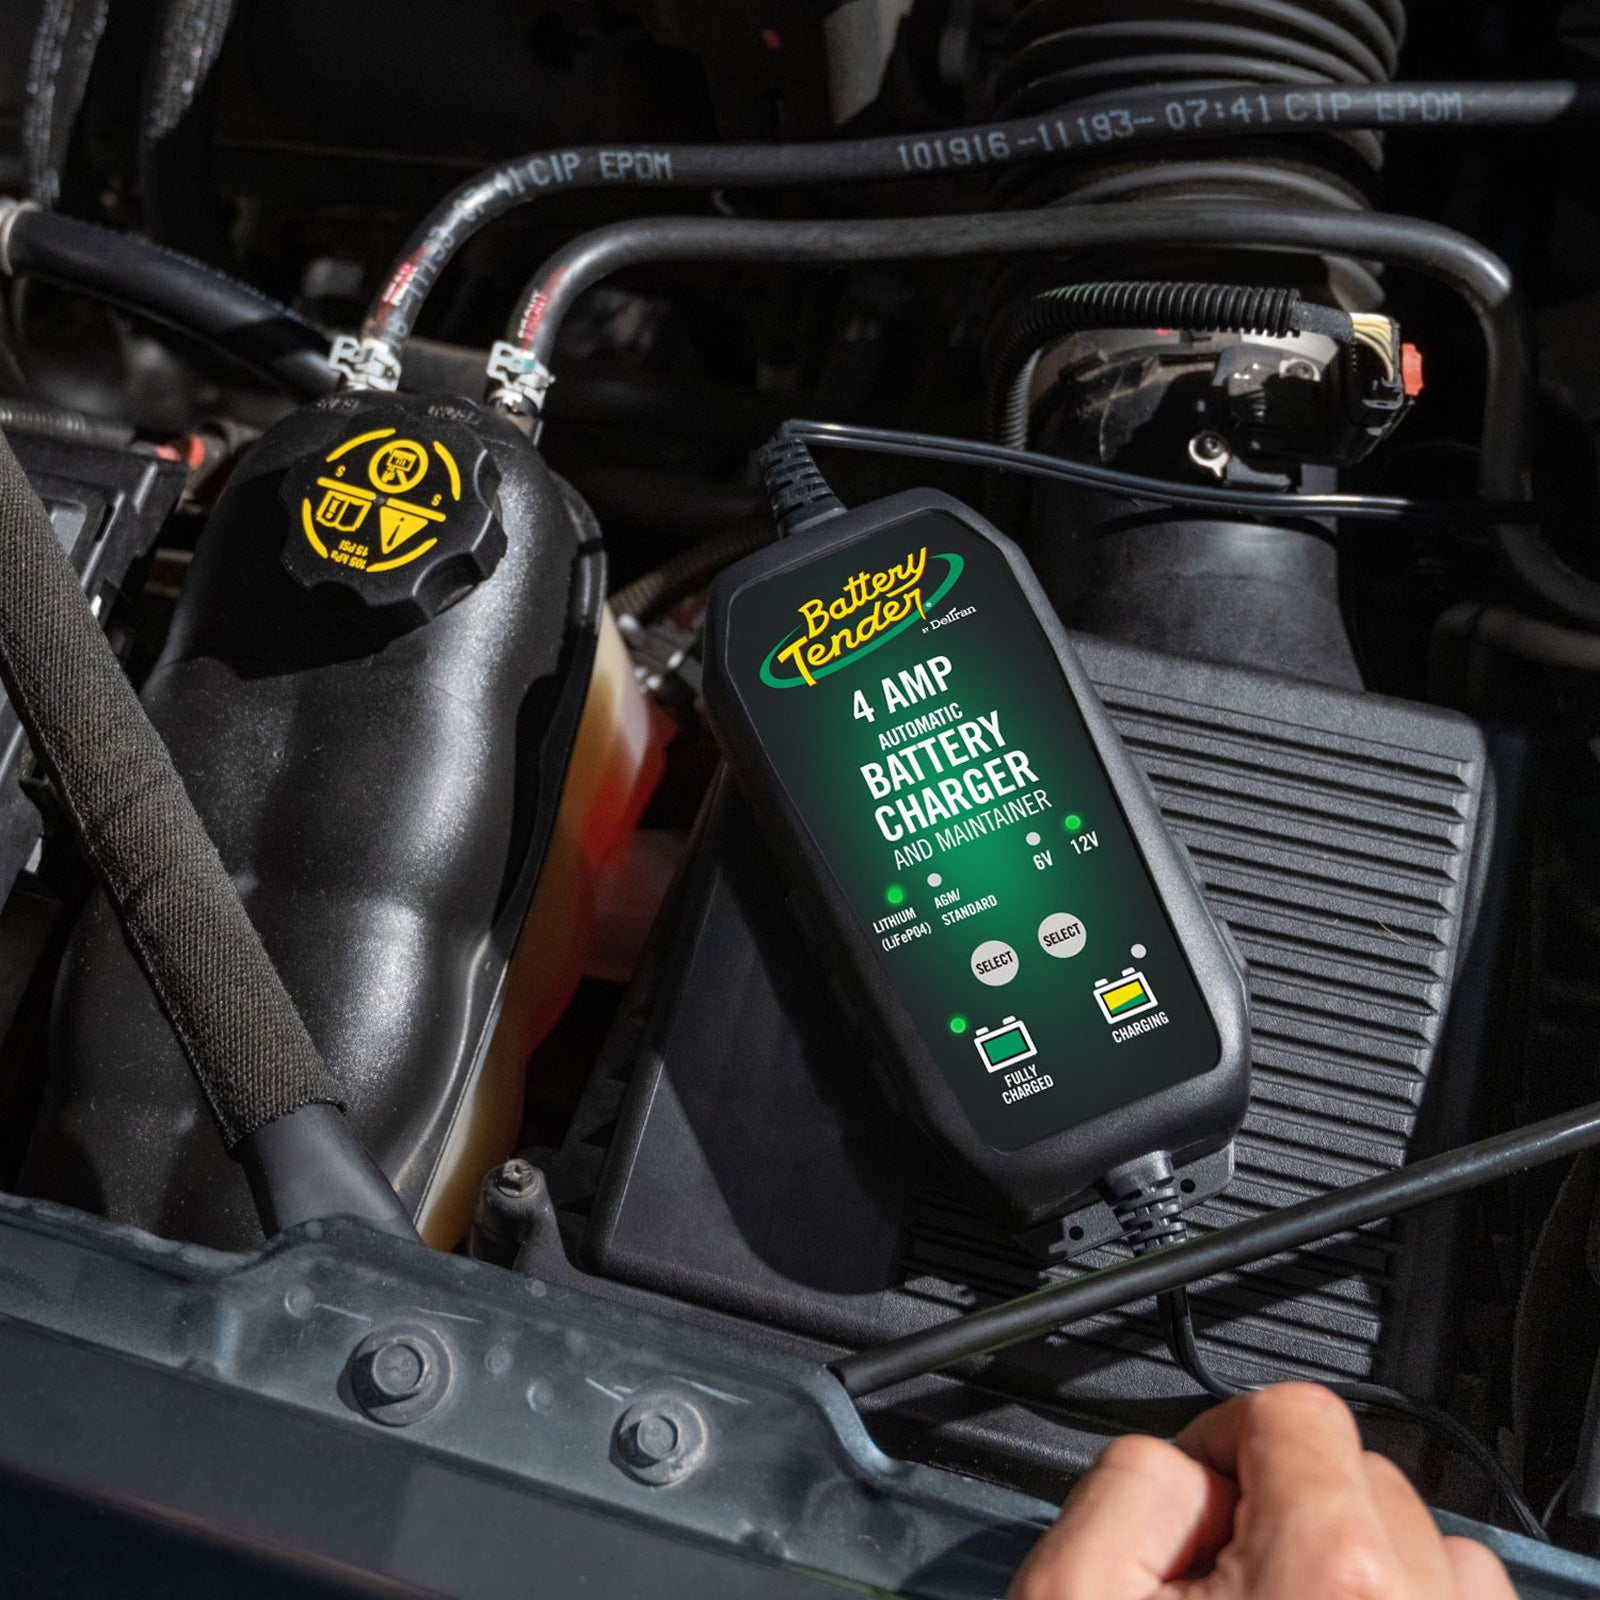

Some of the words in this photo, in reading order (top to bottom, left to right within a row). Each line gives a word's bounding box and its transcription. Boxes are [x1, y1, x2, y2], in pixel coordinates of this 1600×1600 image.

[1284, 91, 1352, 122] CIP
[1373, 90, 1463, 122] EPDM
[527, 151, 580, 188] CIP
[599, 150, 673, 180] EPDM
[330, 550, 350, 565] kPa
[338, 540, 357, 554] PSI
[354, 545, 369, 557] 15
[349, 556, 366, 570] 105
[798, 546, 928, 639] Battery
[776, 587, 928, 687] Tender
[853, 689, 876, 724] 4
[881, 655, 953, 714] AMP
[878, 702, 963, 751] AUTOMATIC
[859, 709, 1007, 800] BATTERY
[874, 750, 1040, 842] CHARGER
[893, 838, 934, 871] AND
[934, 788, 1053, 853] MAINTAINER
[1070, 830, 1100, 856] 12V
[1032, 849, 1054, 871] 6V
[933, 887, 961, 909] AGM/
[941, 894, 998, 926] STANDARD
[872, 906, 918, 934] LITHIUM
[1042, 922, 1082, 948] SELECT
[975, 950, 1015, 975] SELECT
[1111, 1011, 1171, 1044] CHARGING
[1001, 1074, 1055, 1105] CHARGED
[1003, 1063, 1039, 1088] FULLY
